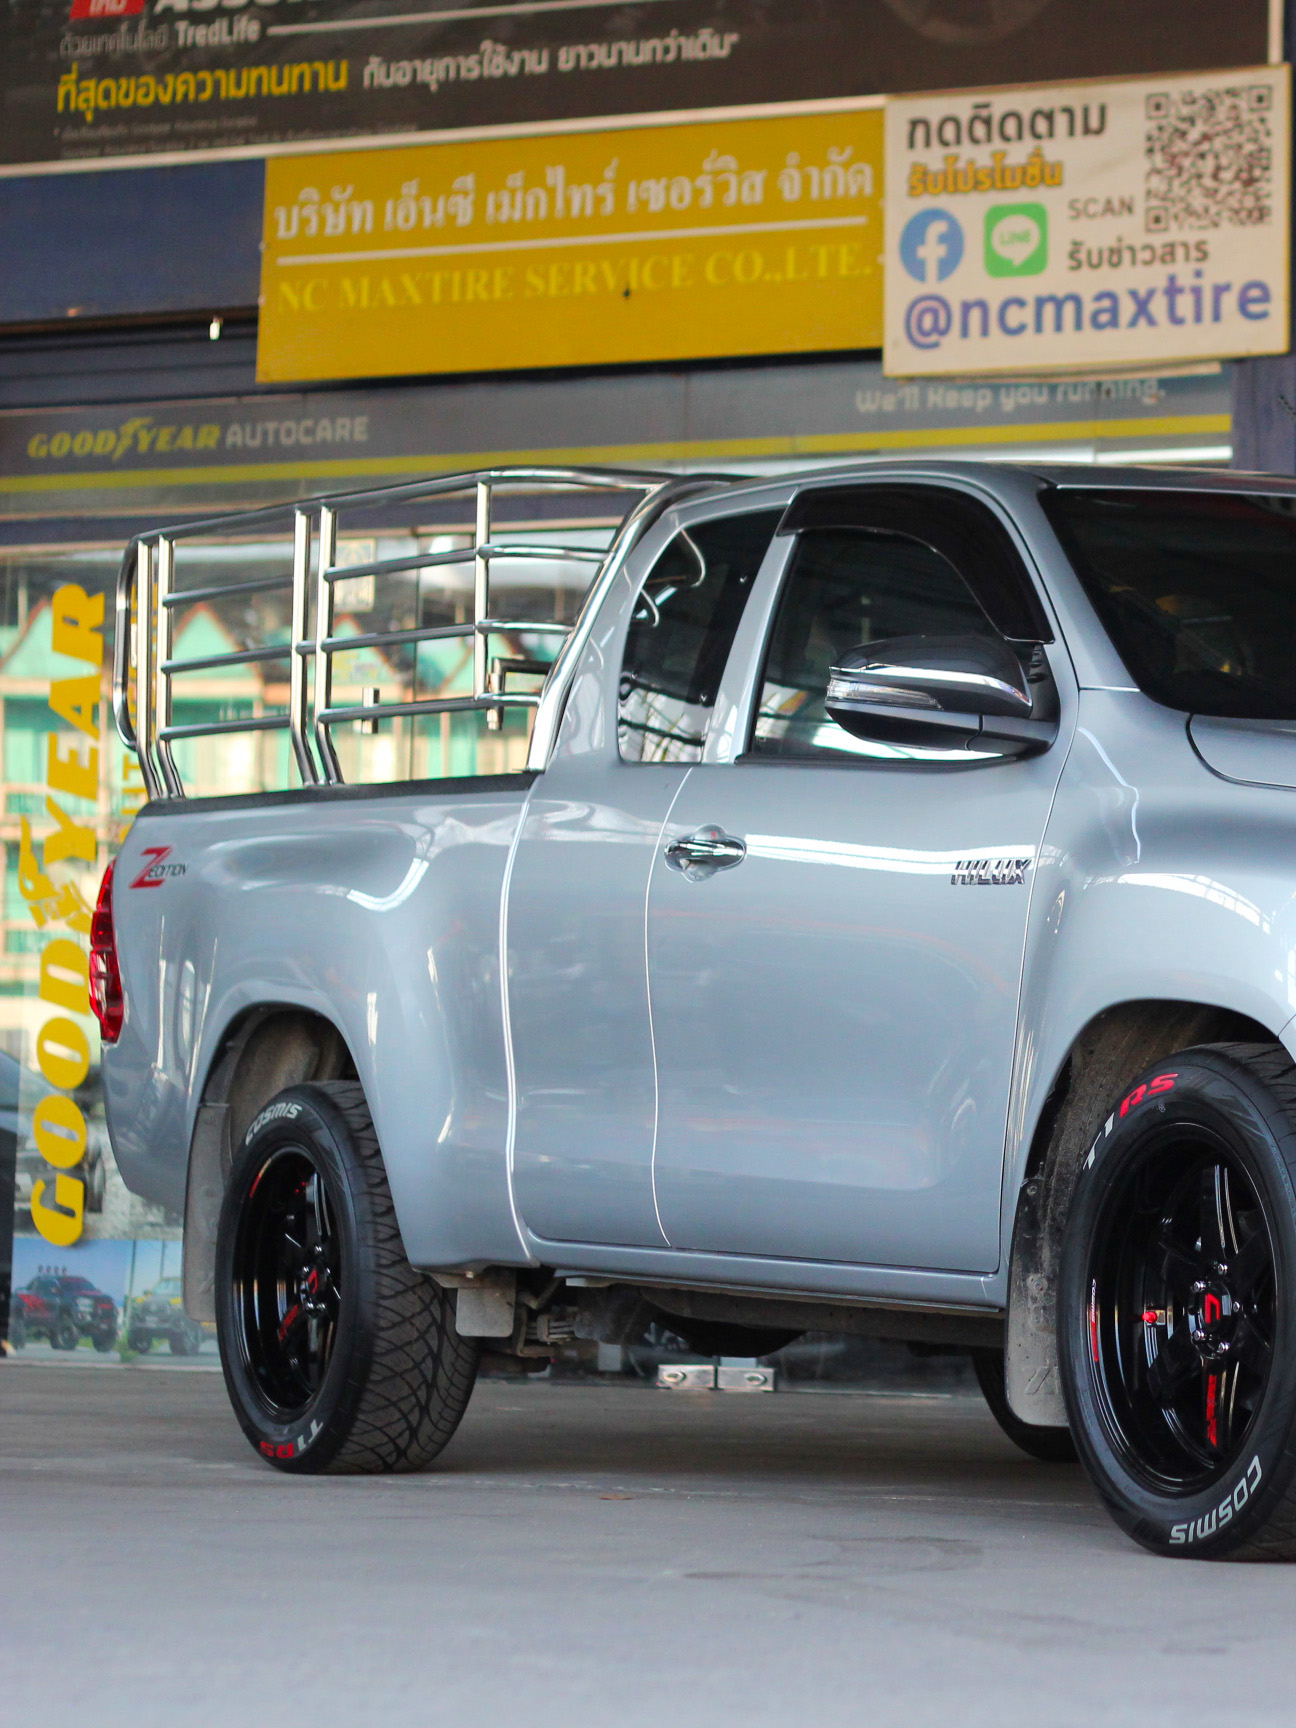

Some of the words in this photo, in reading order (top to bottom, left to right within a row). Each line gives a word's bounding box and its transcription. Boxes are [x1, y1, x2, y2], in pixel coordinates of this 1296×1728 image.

[174, 17, 261, 48] TredLife
[57, 59, 349, 124] ที่สุดของความทนทาน
[907, 102, 1107, 149] กดติดตาม
[274, 184, 375, 240] บริษัท
[383, 172, 476, 232] เอ็นซี
[626, 148, 768, 214] เซอร์วิส
[778, 145, 873, 202] จำกัด
[908, 146, 1063, 197] รับโปรโมชั่น
[1068, 196, 1134, 220] SCAN
[1000, 228, 1032, 246] LINE
[1068, 236, 1209, 271] รับข่าวสาร
[278, 277, 329, 313] NC
[339, 266, 515, 309] MAXTIRE
[524, 252, 696, 298] SERVICE
[905, 269, 1271, 350] @ncmaxtire
[27, 419, 220, 460] GOODYEAR
[225, 416, 369, 448] AUTOCARE
[951, 858, 1031, 886] HILUX
[30, 584, 105, 1246] GOODYEAR
[1119, 1072, 1180, 1118] RS
[245, 1101, 303, 1146] COSMIS
[1168, 1454, 1263, 1546] COSMIS
